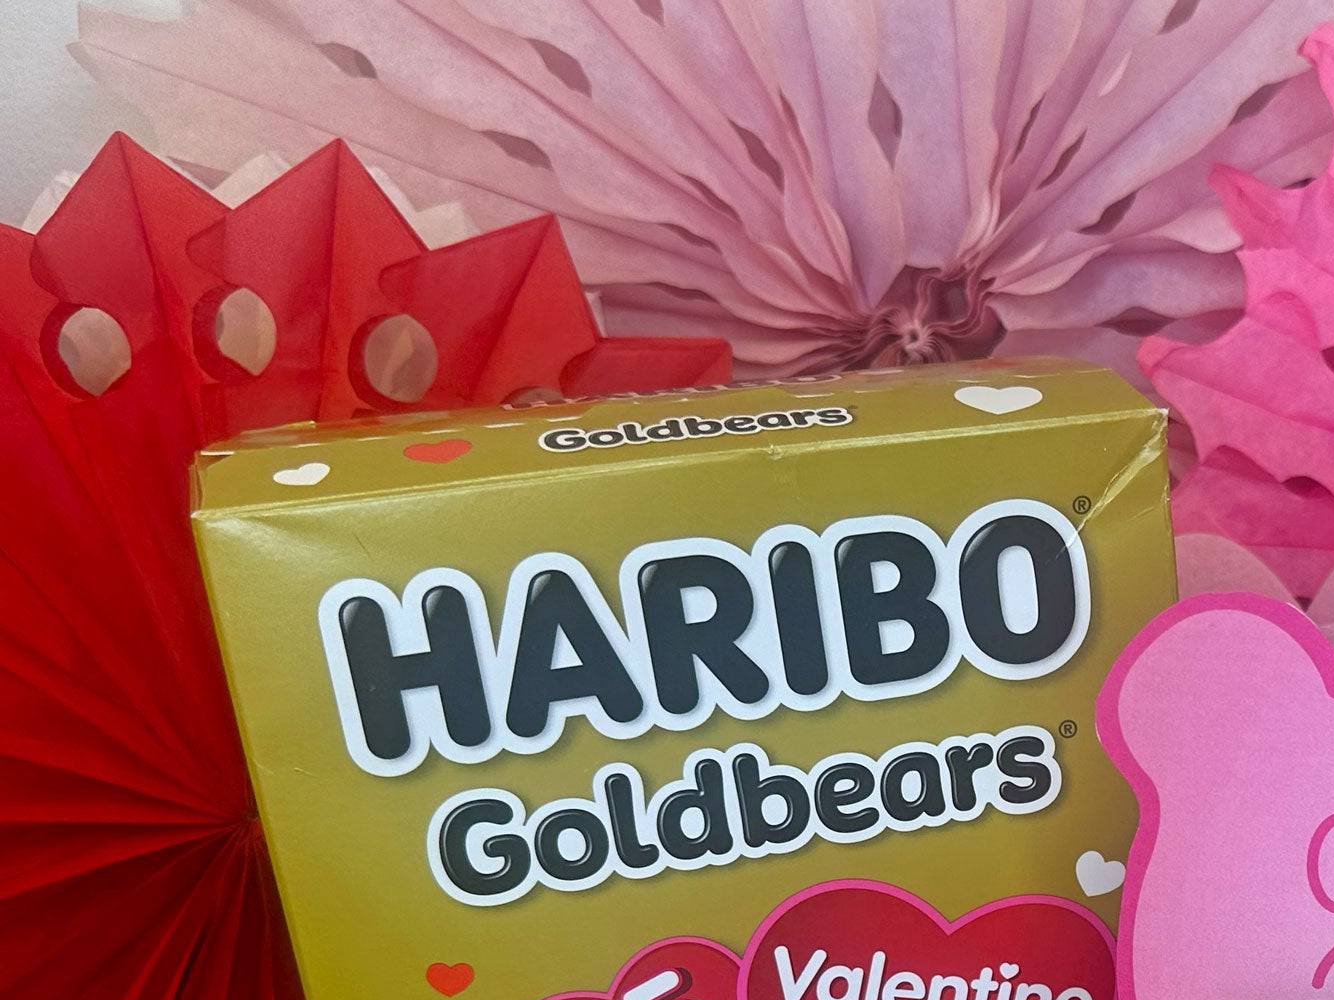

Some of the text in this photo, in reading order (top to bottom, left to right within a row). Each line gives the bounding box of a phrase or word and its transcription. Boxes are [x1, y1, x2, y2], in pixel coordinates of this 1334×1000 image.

[539, 408, 853, 452] Goldbears
[320, 500, 1088, 774] HARIBO
[429, 728, 1061, 904] Goldbears
